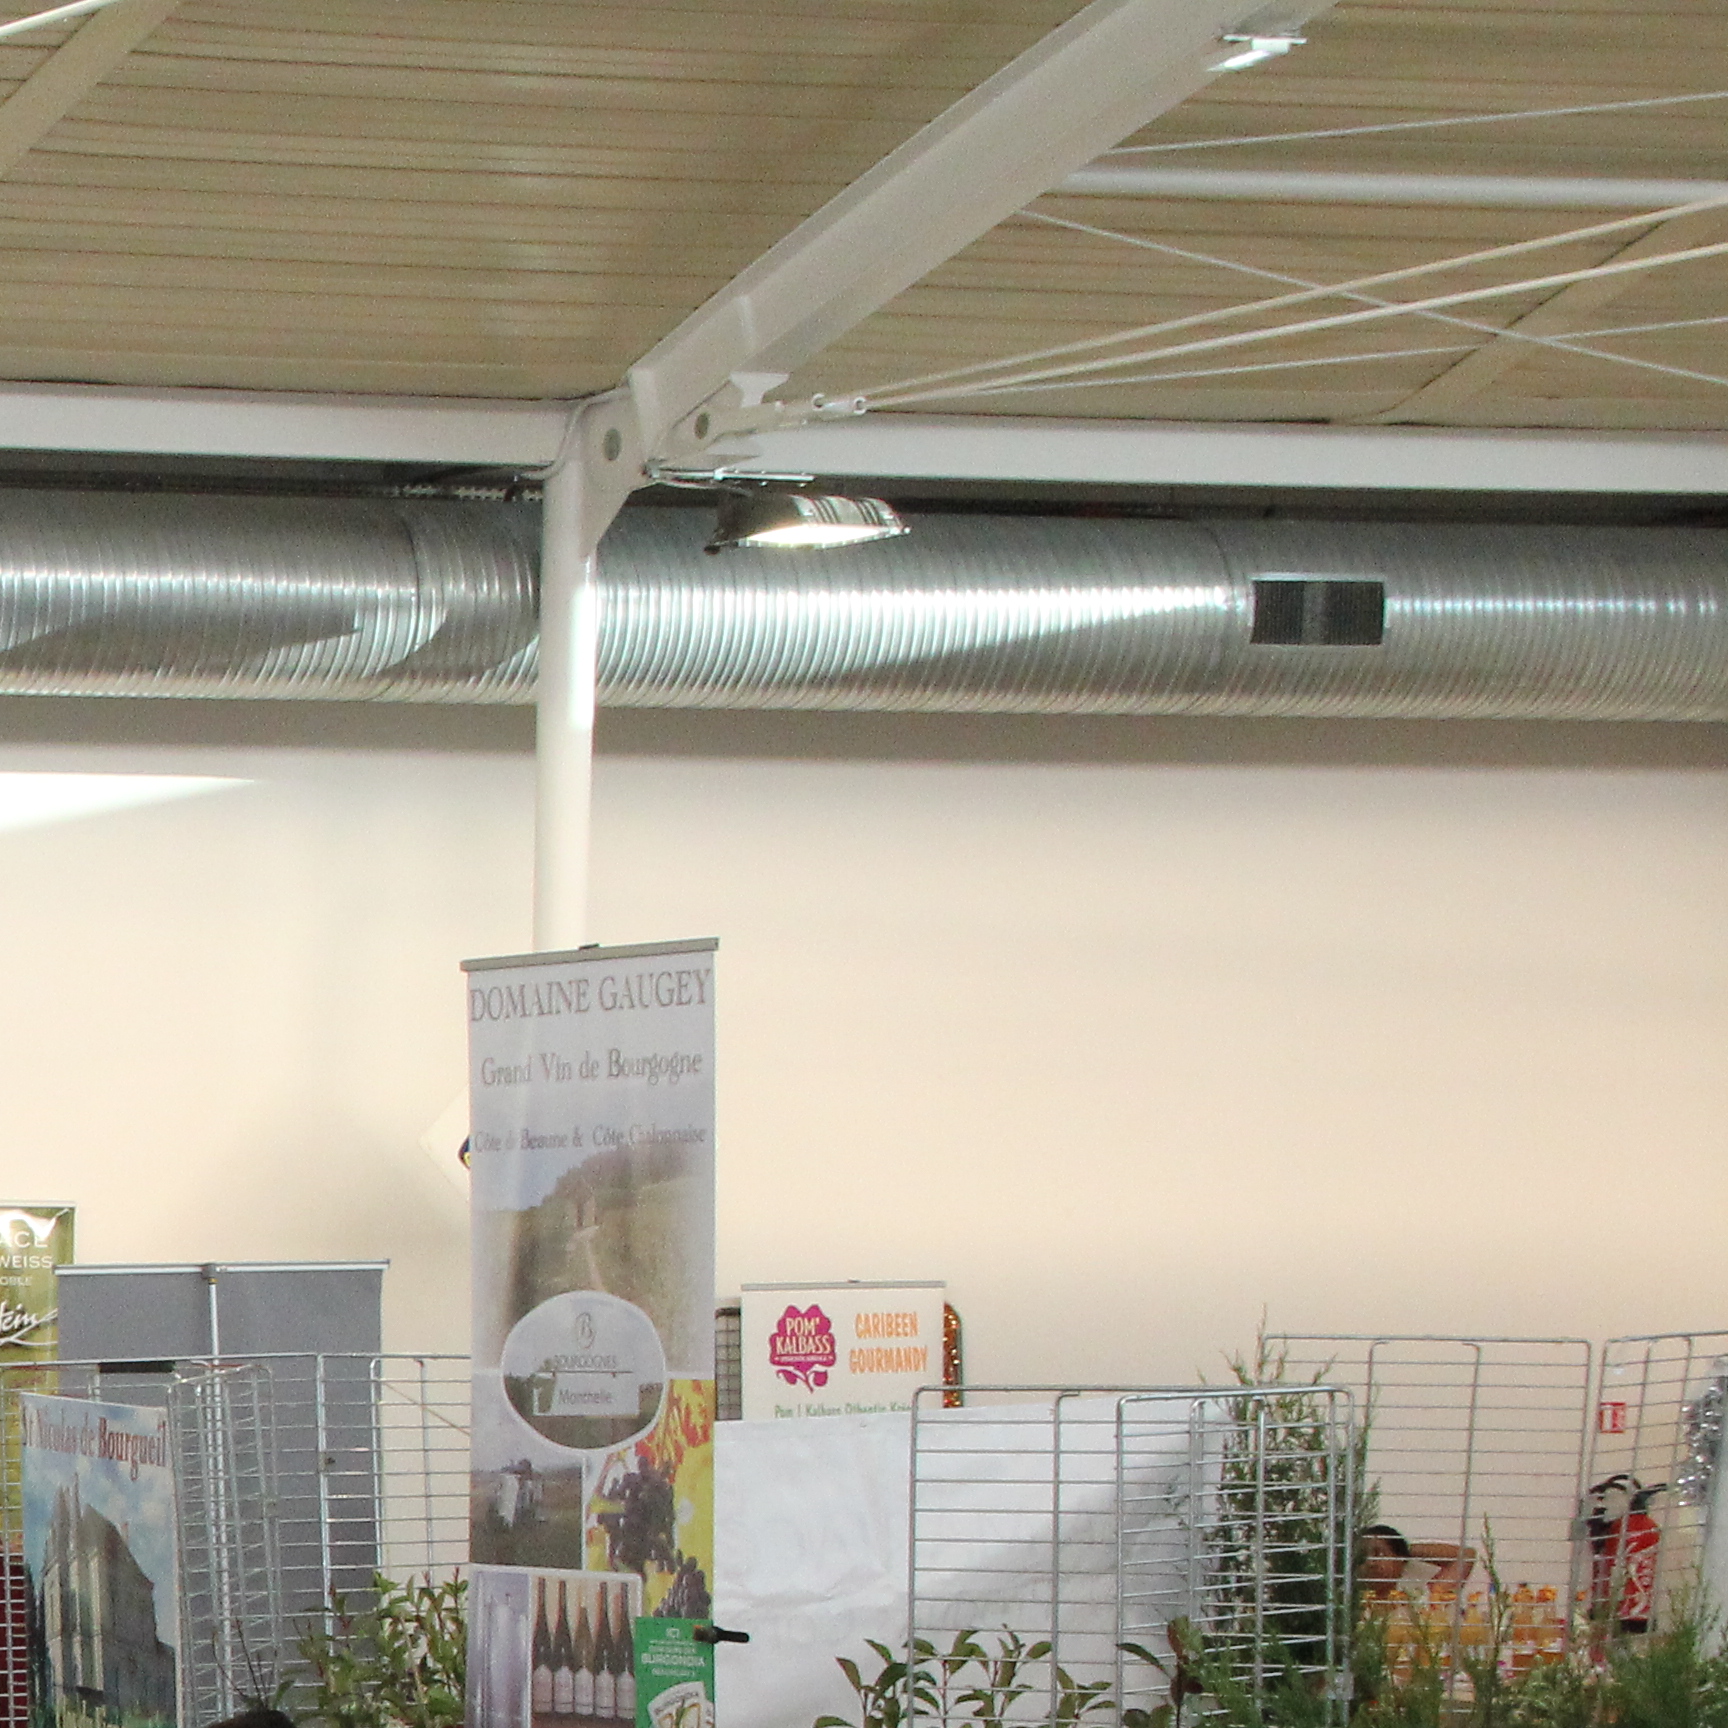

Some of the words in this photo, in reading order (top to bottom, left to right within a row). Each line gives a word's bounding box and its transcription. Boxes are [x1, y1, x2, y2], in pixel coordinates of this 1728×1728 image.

[471, 979, 590, 1021] DOMAINE
[599, 968, 711, 1012] GAUGEY
[482, 1055, 532, 1086] Grand
[539, 1052, 573, 1081] Vin
[579, 1051, 600, 1079] de
[608, 1048, 703, 1085] Bourgogne
[785, 1317, 821, 1337] POM'
[775, 1334, 831, 1355] KALBASS
